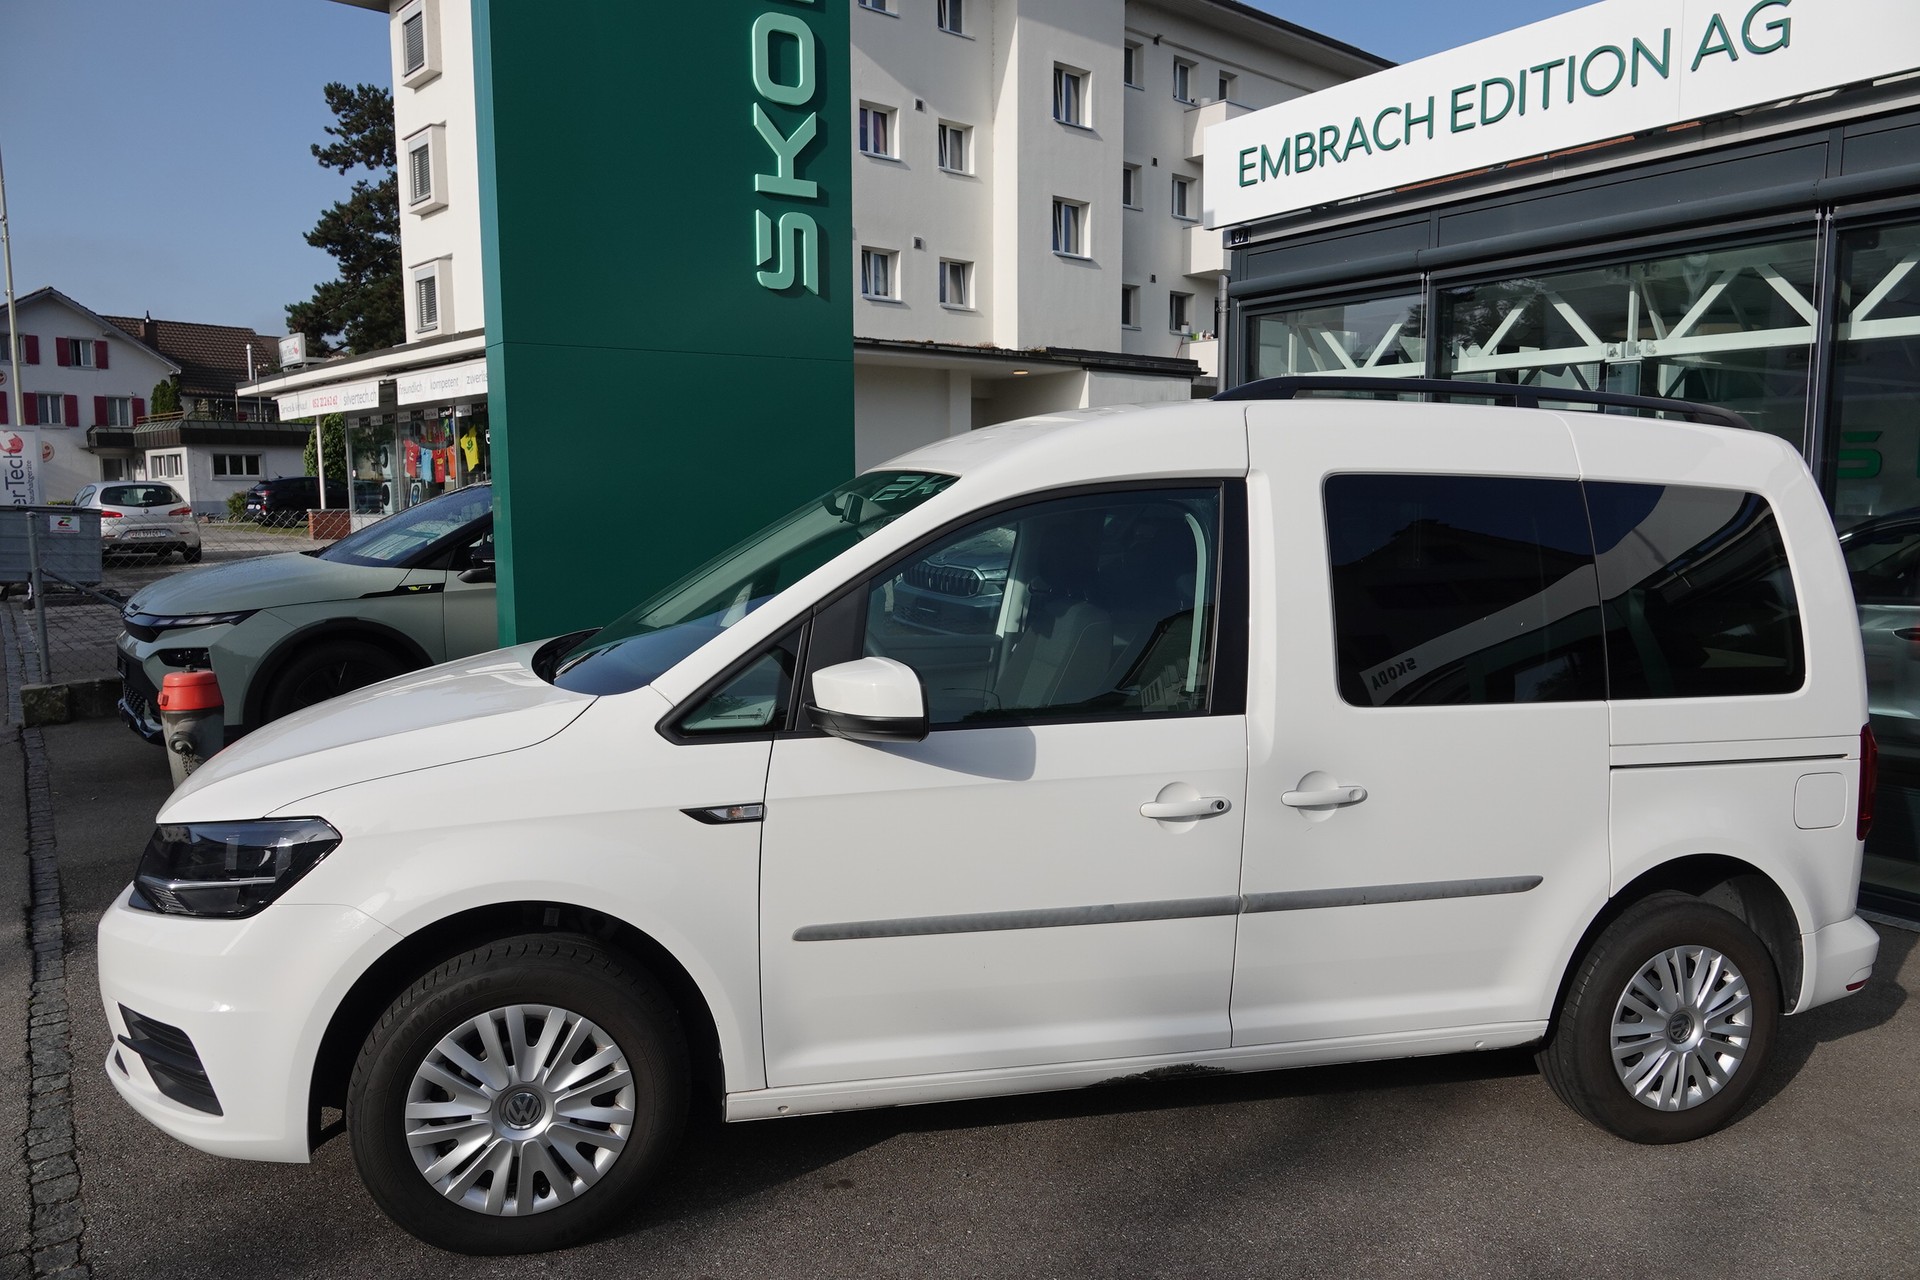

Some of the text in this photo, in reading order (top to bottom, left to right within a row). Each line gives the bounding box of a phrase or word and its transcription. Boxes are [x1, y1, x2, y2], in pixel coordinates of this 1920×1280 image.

[1239, 0, 1791, 187] EMBRACH EDITION AG
[343, 386, 377, 406] silvertech.ch
